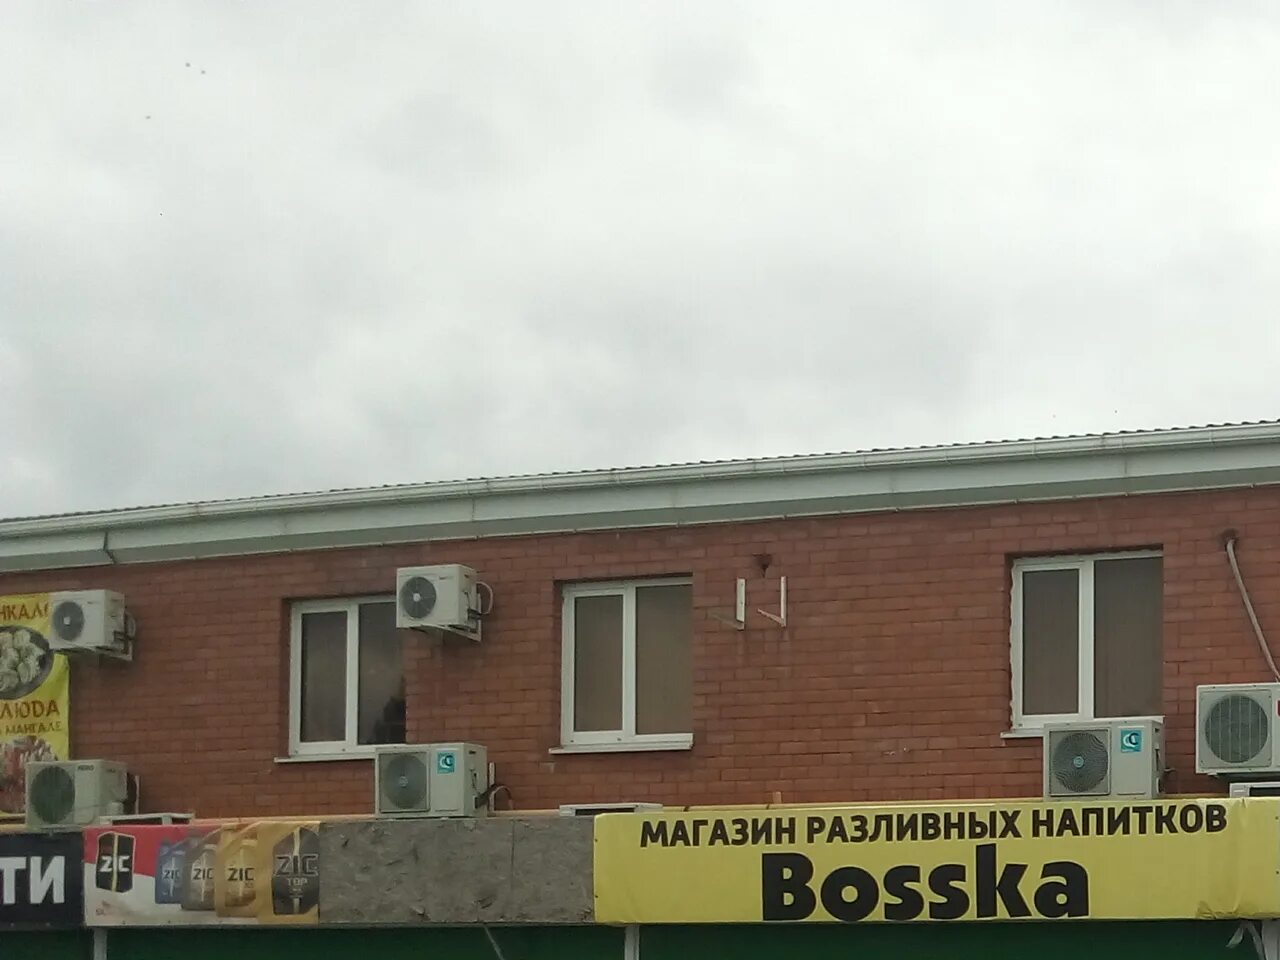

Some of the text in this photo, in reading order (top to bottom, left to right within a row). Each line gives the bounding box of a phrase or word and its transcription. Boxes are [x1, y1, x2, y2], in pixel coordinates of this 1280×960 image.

[640, 804, 1228, 847] МАГАЗИН РАЗЛИВНЫХ НАПИТКОВ
[162, 869, 181, 880] ZIC
[192, 867, 215, 881] ZIC
[227, 867, 255, 881] ZIC
[273, 853, 319, 877] ZIC
[0, 855, 65, 905] ТИ
[286, 877, 308, 886] TOP
[762, 843, 1090, 922] Bosska
